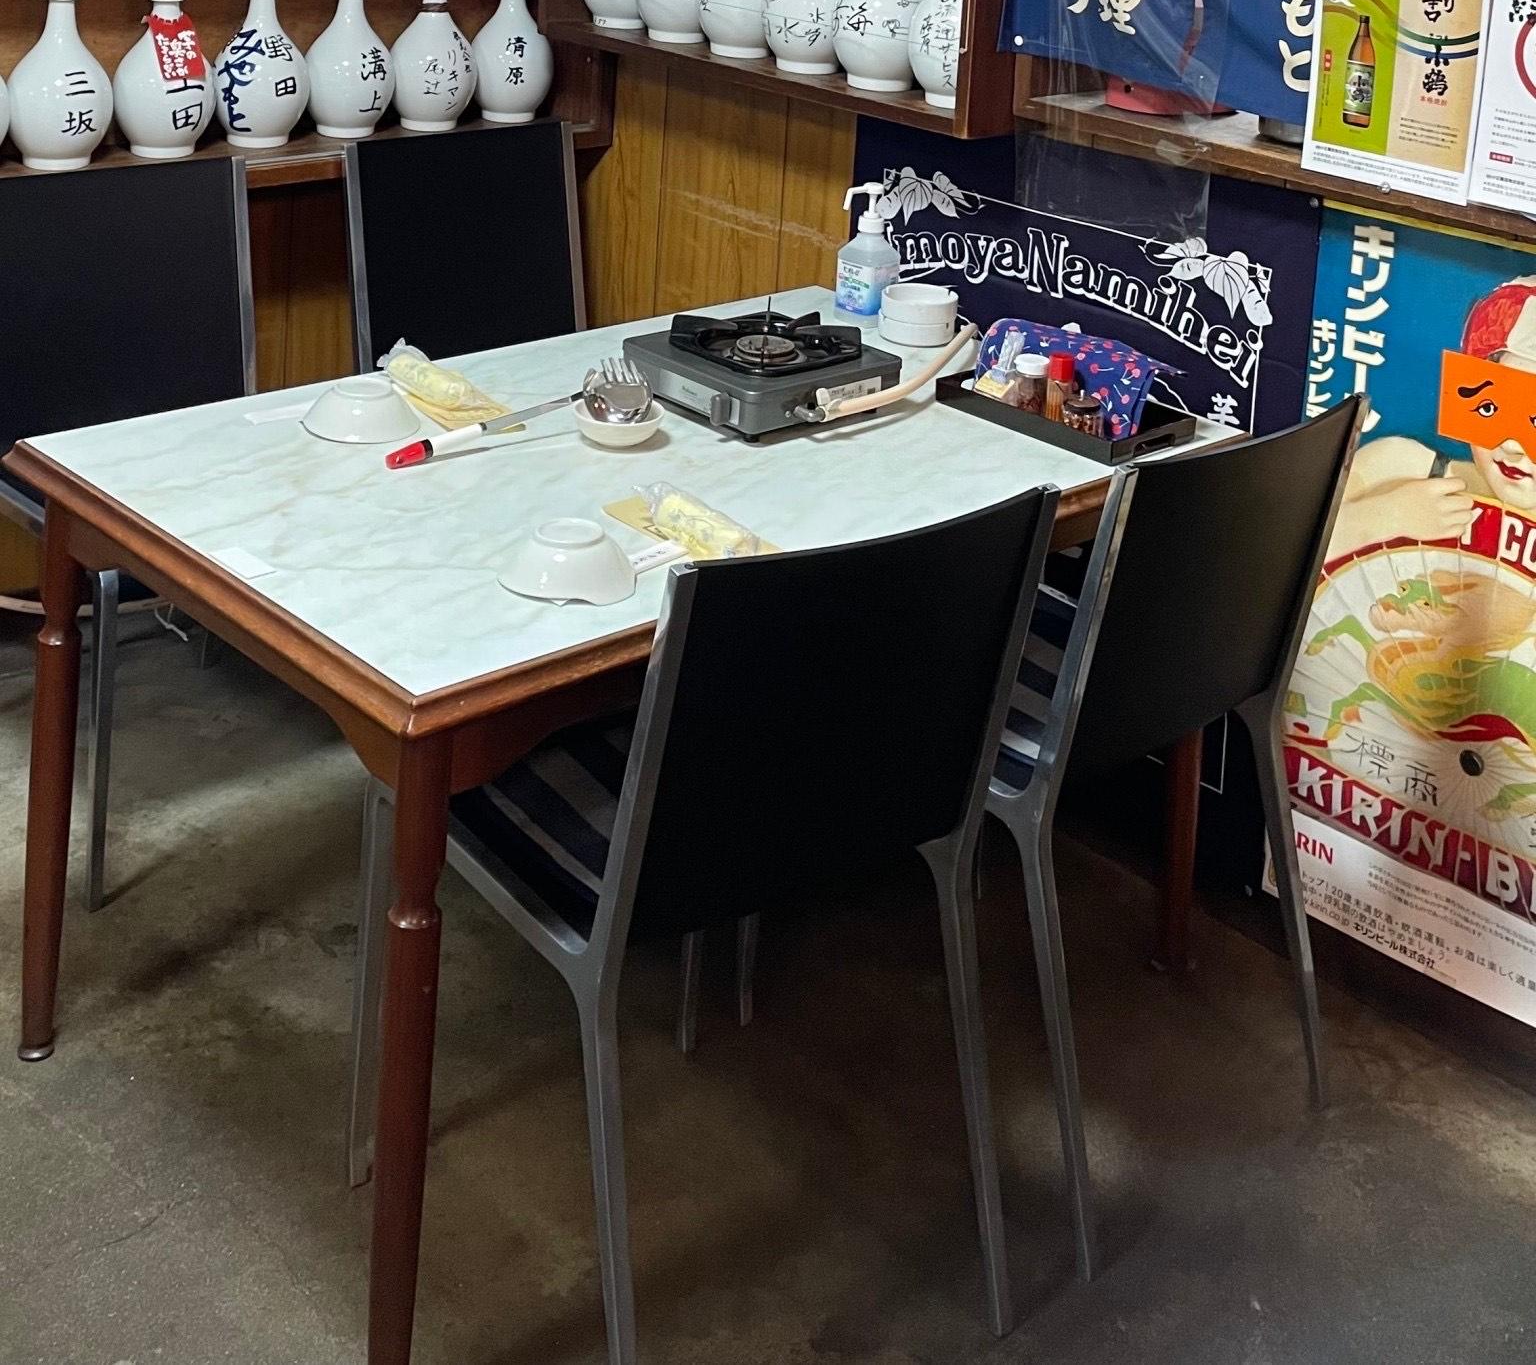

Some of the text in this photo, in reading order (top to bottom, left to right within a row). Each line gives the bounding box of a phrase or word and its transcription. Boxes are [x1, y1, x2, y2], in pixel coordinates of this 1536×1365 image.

[264, 34, 298, 98] 野田
[359, 46, 388, 113] 溝上
[504, 35, 528, 86] 清原
[61, 69, 98, 135] 三坂
[1295, 756, 1536, 915] KIRIN-B
[1295, 831, 1335, 866] RIN
